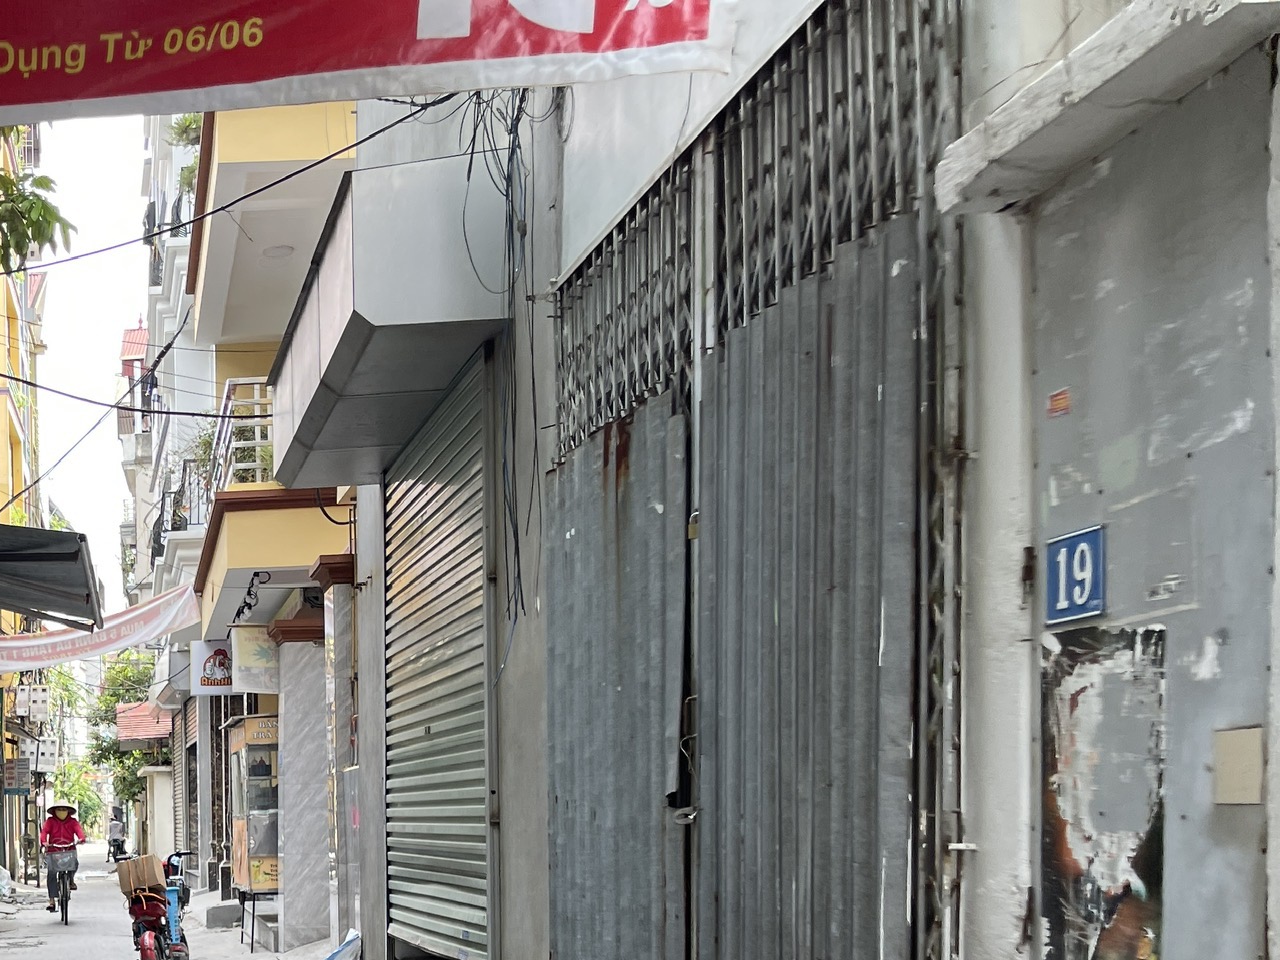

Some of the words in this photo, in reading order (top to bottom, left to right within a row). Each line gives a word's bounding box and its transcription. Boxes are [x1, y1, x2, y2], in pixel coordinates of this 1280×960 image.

[105, 31, 154, 64] Từ
[163, 17, 265, 55] 06/06
[1055, 542, 1093, 610] 19
